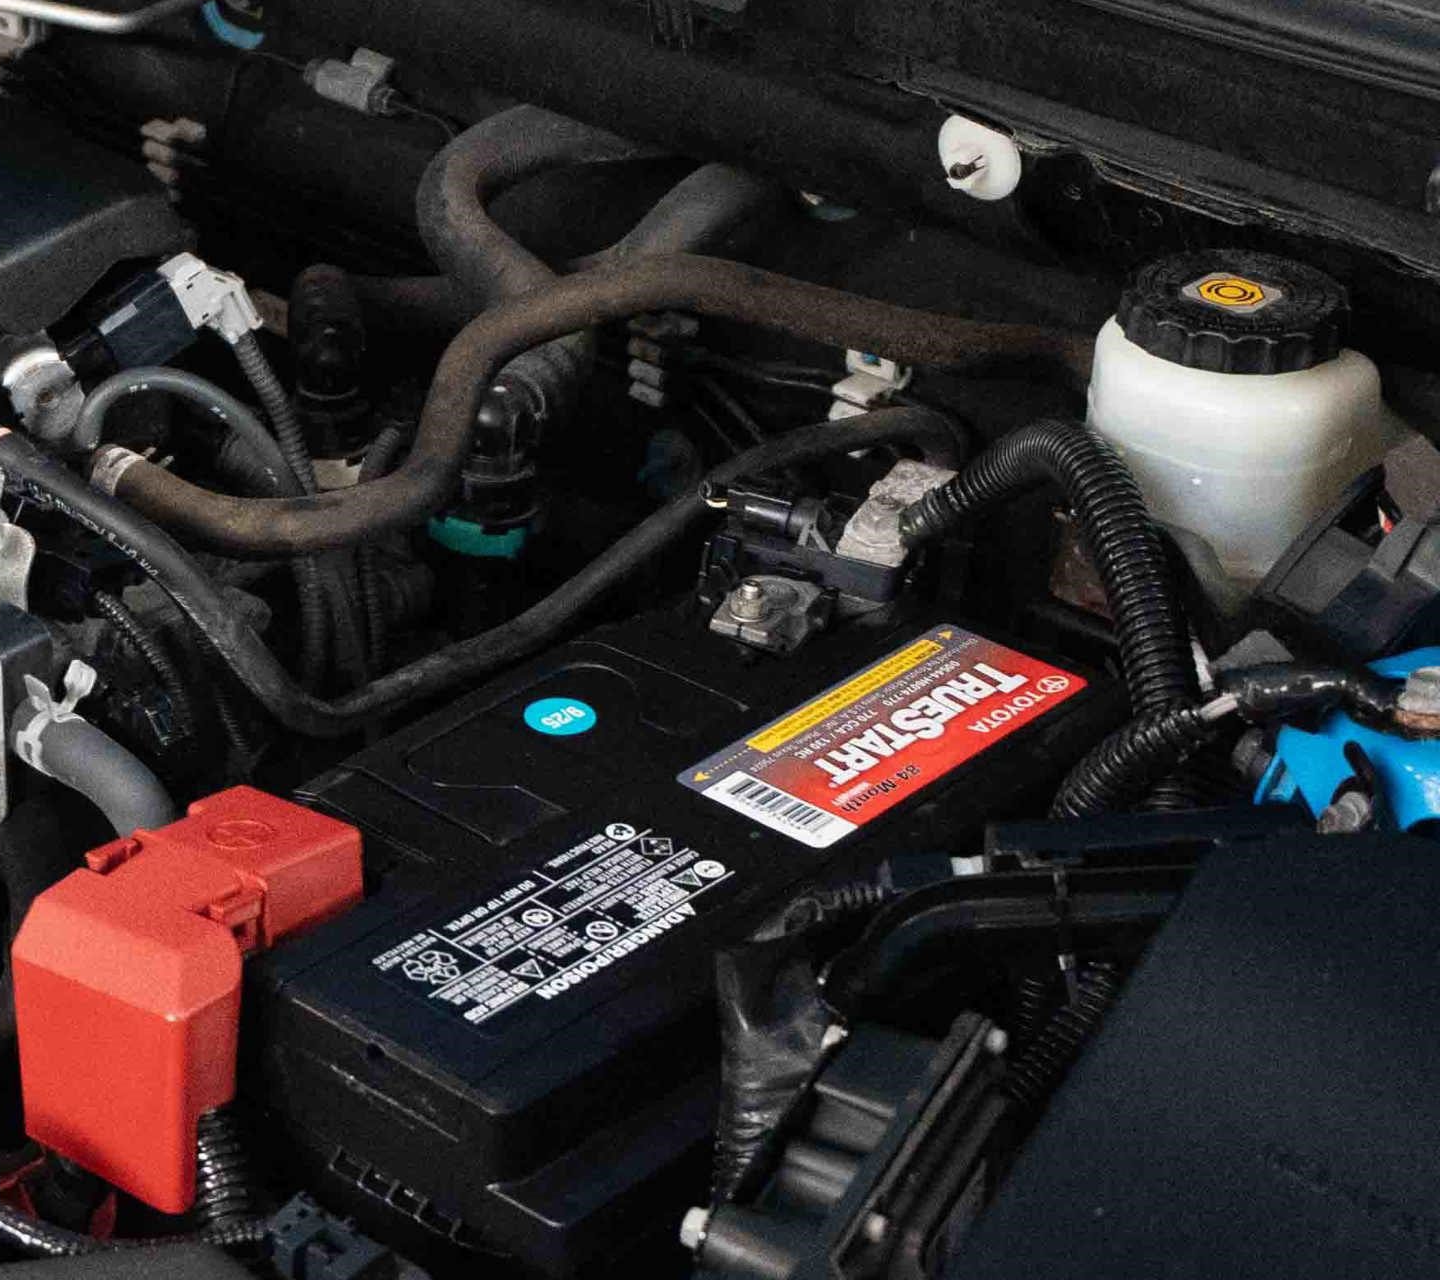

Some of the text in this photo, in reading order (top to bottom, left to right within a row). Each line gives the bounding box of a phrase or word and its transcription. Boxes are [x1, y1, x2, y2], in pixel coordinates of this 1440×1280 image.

[814, 662, 1031, 786] TRUESTART
[966, 691, 1046, 735] TOYOTA
[840, 764, 921, 812] 84 Month
[500, 888, 523, 902] NOT
[535, 913, 685, 1000] DANGER/POISON
